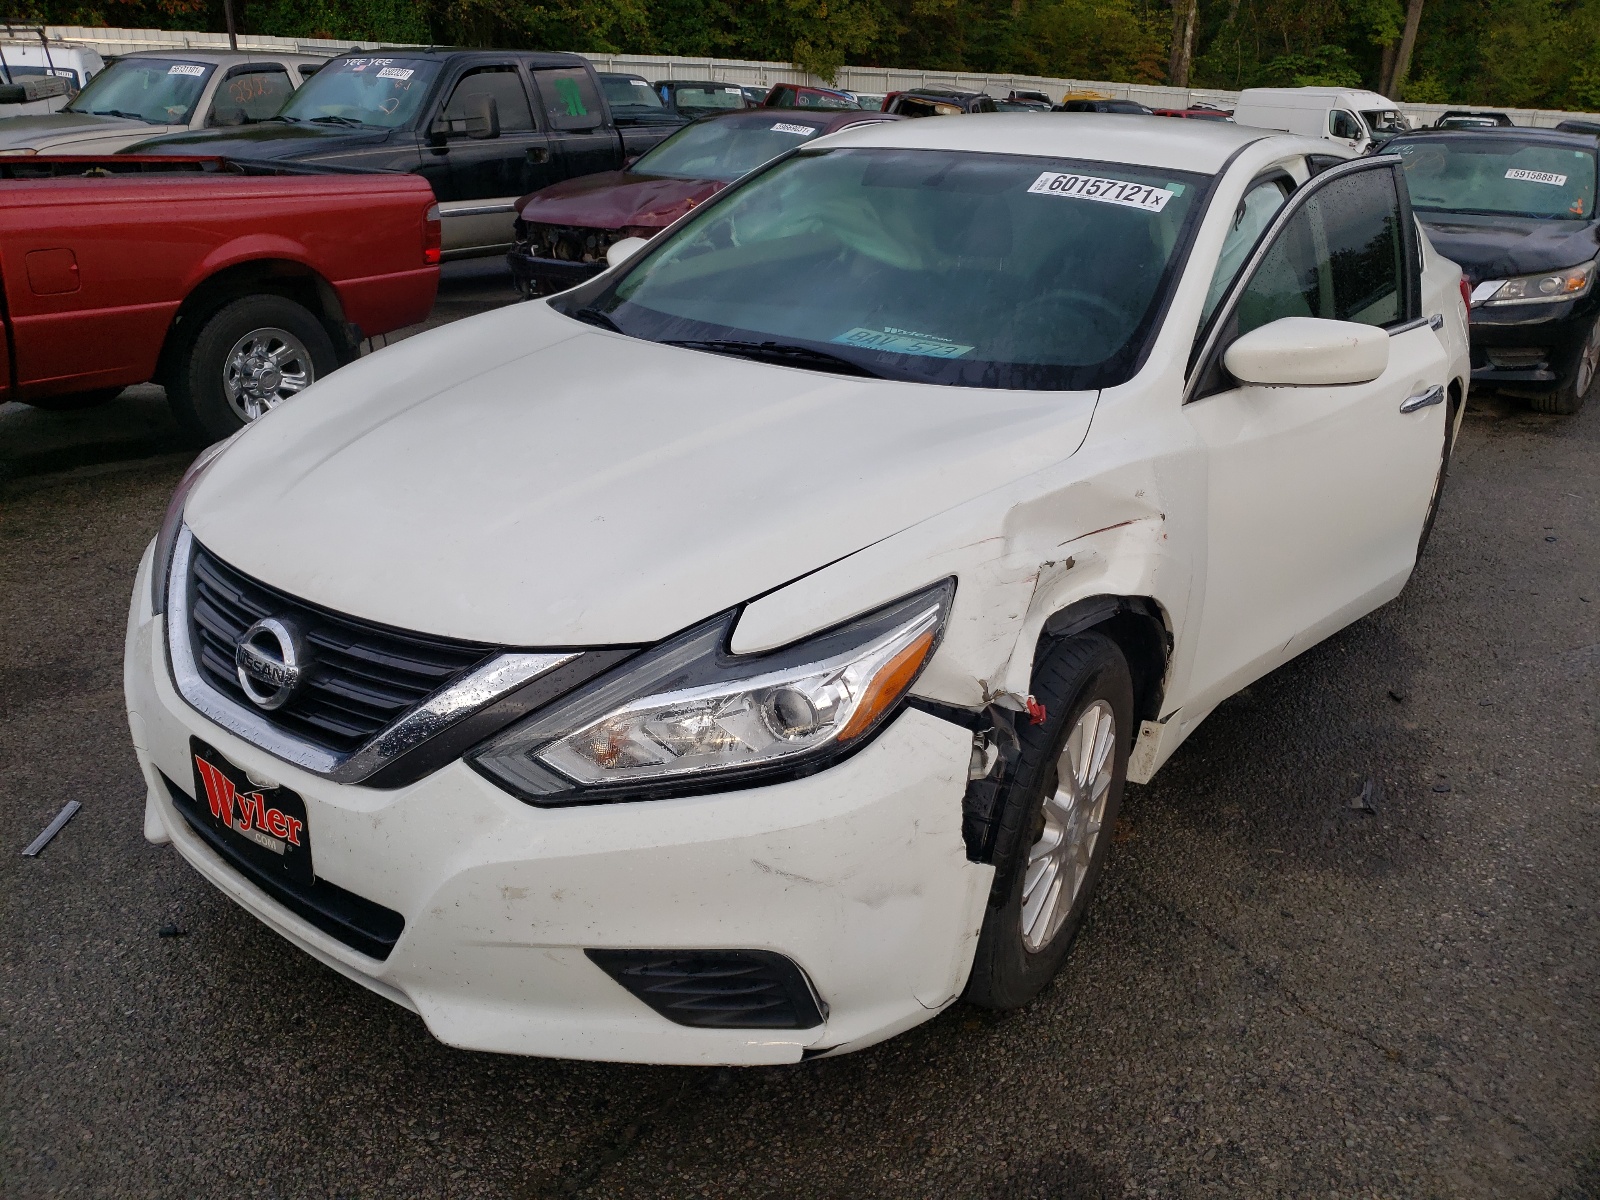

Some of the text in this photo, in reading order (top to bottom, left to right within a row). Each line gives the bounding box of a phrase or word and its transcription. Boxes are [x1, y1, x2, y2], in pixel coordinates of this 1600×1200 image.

[906, 341, 958, 356] 573
[239, 645, 286, 684] NISSAN
[195, 754, 302, 847] Wyler
